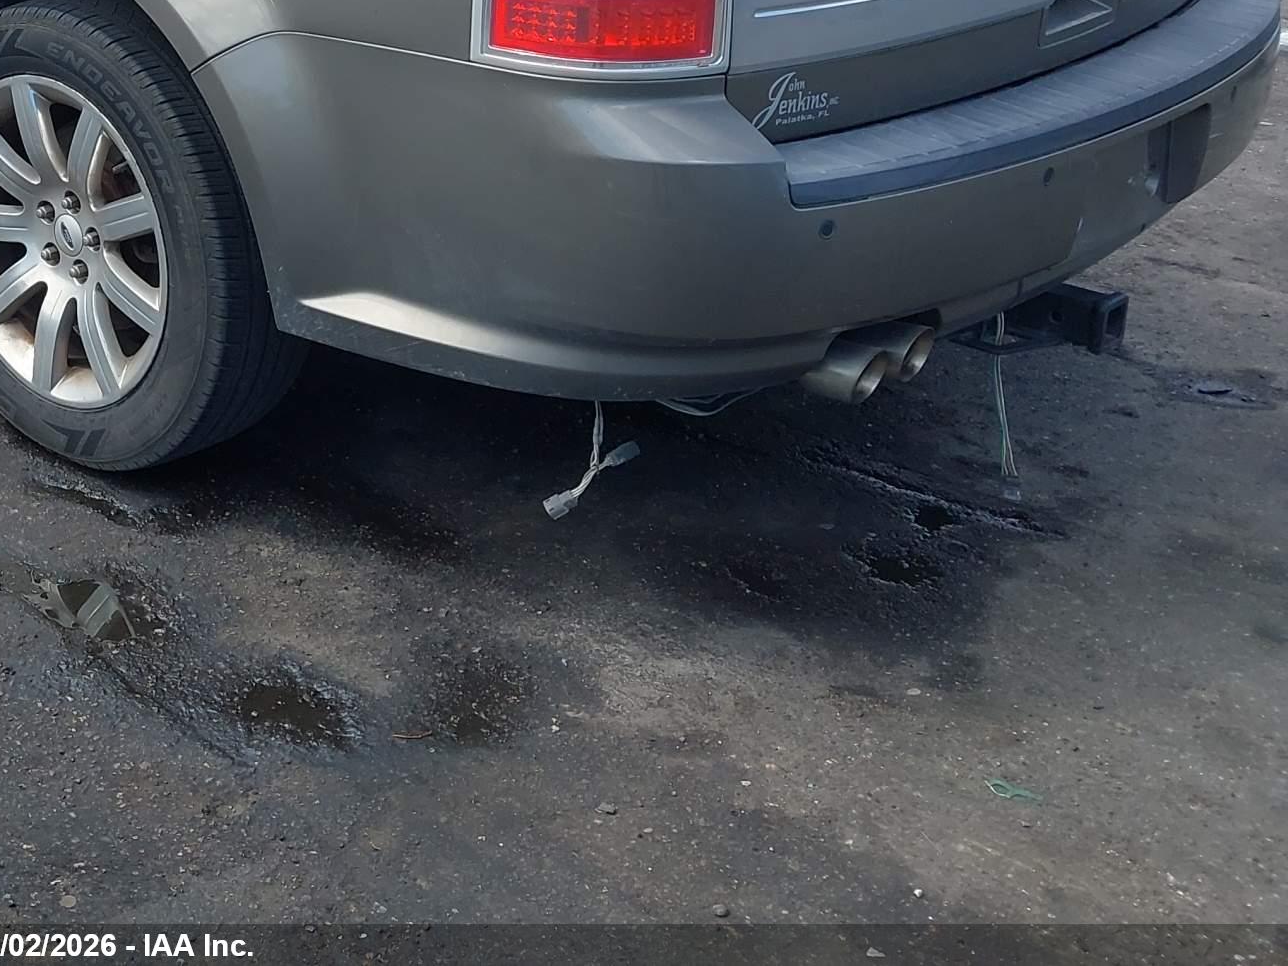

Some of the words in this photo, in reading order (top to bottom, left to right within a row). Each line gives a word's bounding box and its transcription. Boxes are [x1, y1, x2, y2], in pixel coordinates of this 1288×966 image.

[46, 40, 174, 195] ENDEAVOR
[775, 114, 815, 125] Palatka,
[818, 110, 829, 118] FL
